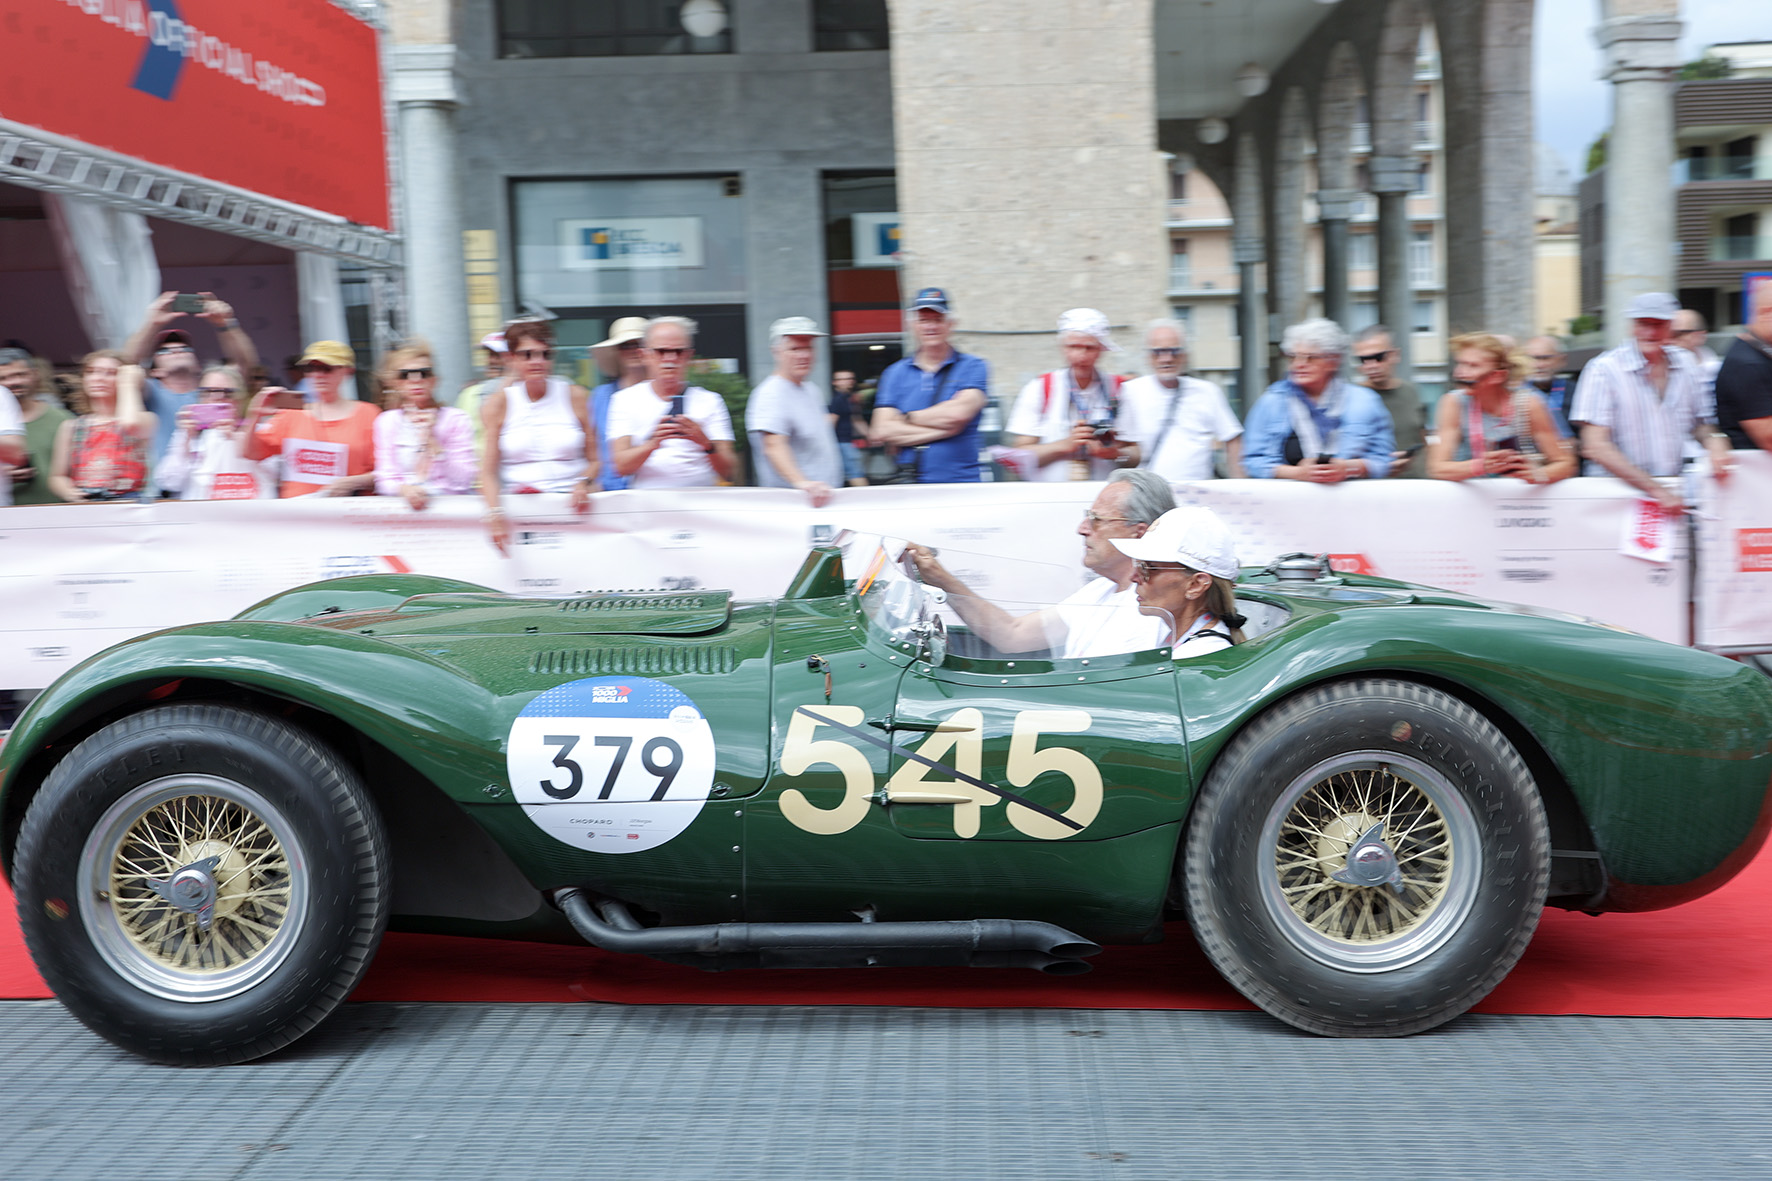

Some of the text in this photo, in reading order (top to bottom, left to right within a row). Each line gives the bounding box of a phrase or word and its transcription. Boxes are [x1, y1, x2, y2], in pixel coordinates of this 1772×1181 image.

[592, 696, 629, 704] MIGLIA
[540, 735, 684, 801] 379
[779, 705, 1104, 840] 545
